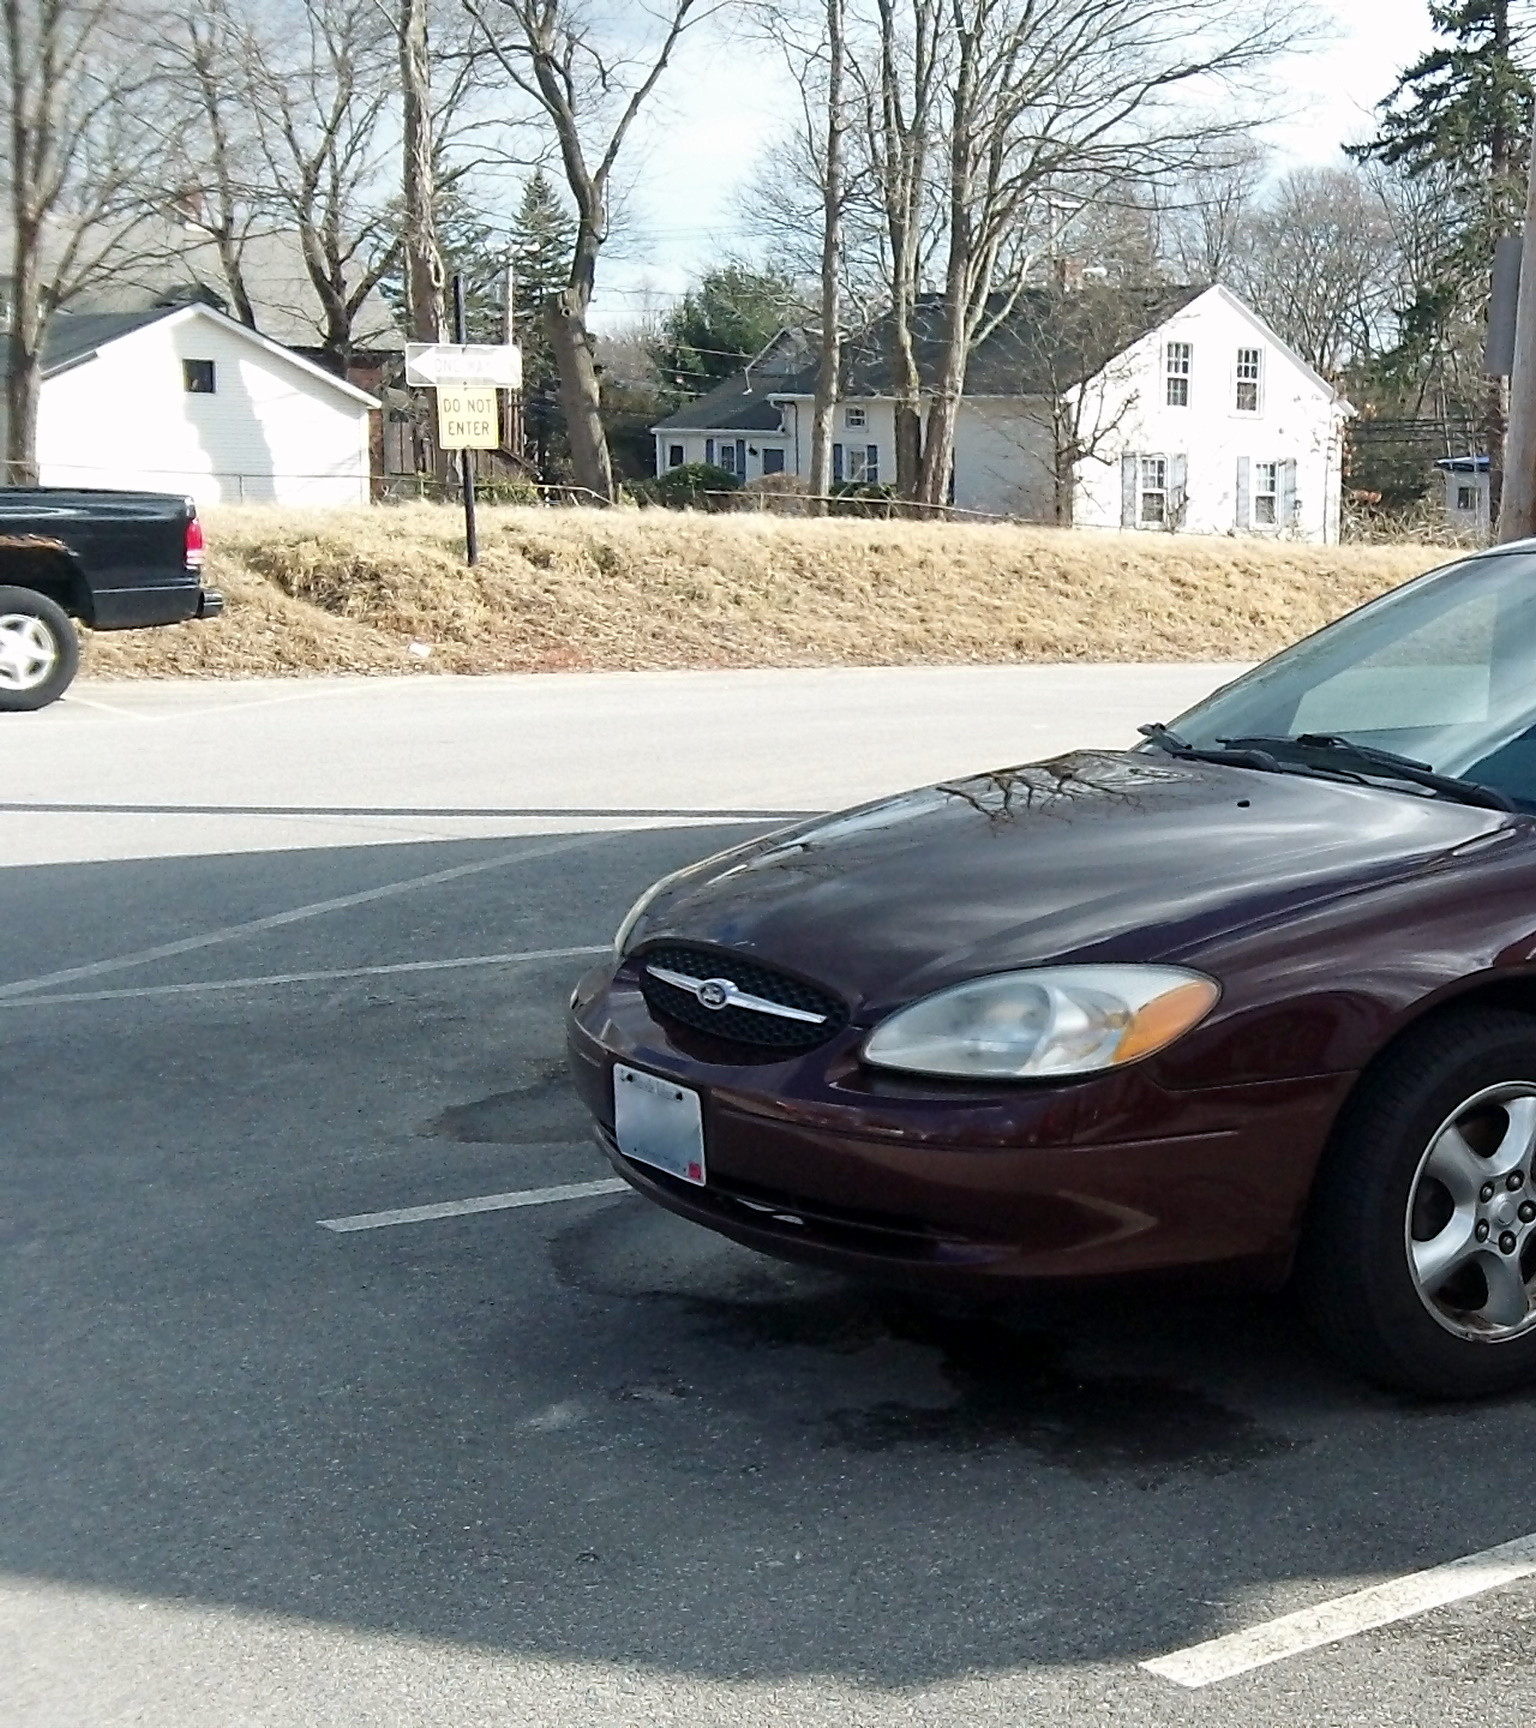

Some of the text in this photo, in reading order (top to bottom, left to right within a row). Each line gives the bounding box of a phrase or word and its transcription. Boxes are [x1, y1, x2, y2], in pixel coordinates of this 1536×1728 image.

[443, 398, 492, 413] DO NOT
[448, 421, 490, 436] ENTER
